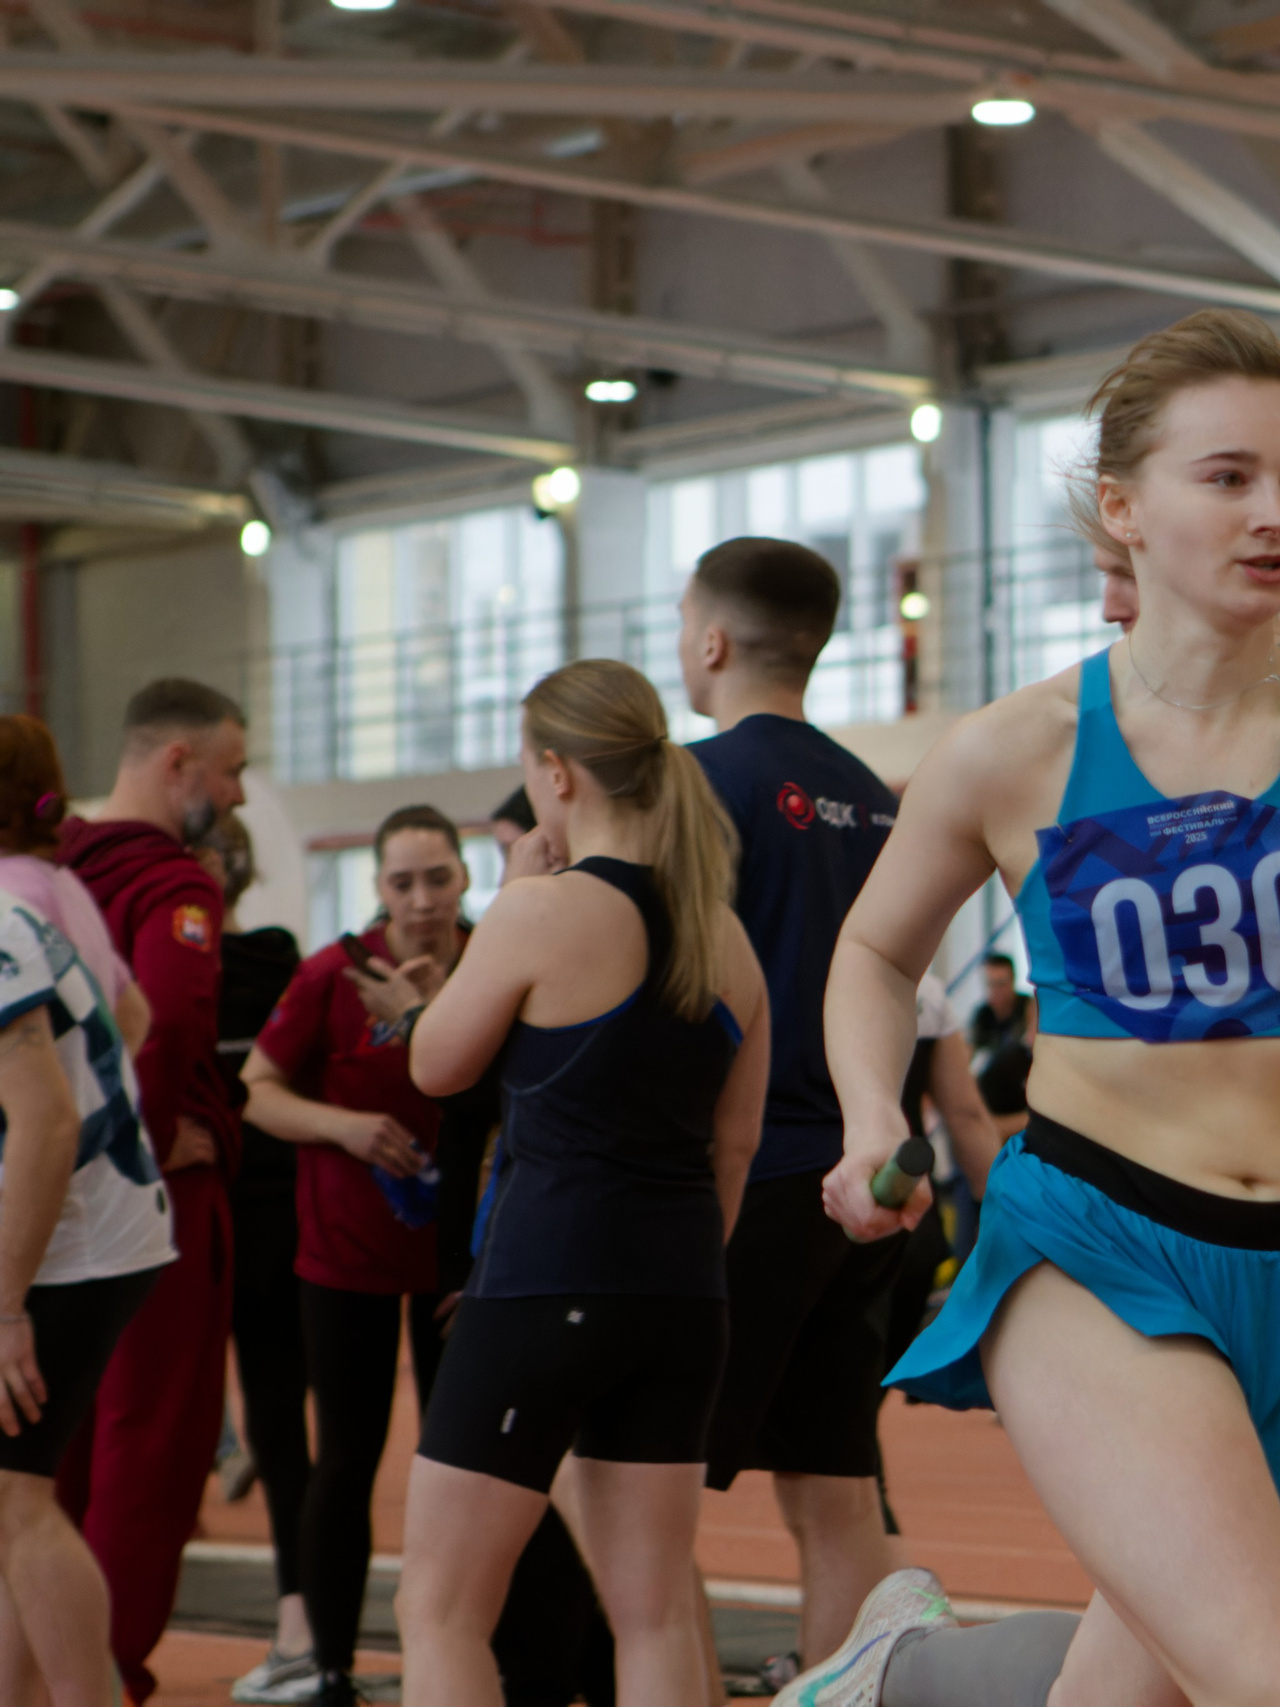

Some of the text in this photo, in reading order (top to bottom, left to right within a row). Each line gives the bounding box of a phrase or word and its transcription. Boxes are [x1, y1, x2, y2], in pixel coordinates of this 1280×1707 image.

[1147, 799, 1235, 825] ВСЕРОССИЙСКИЙ
[1162, 818, 1225, 836] ФЕСТИВАЛЬ
[1185, 831, 1207, 844] 2025
